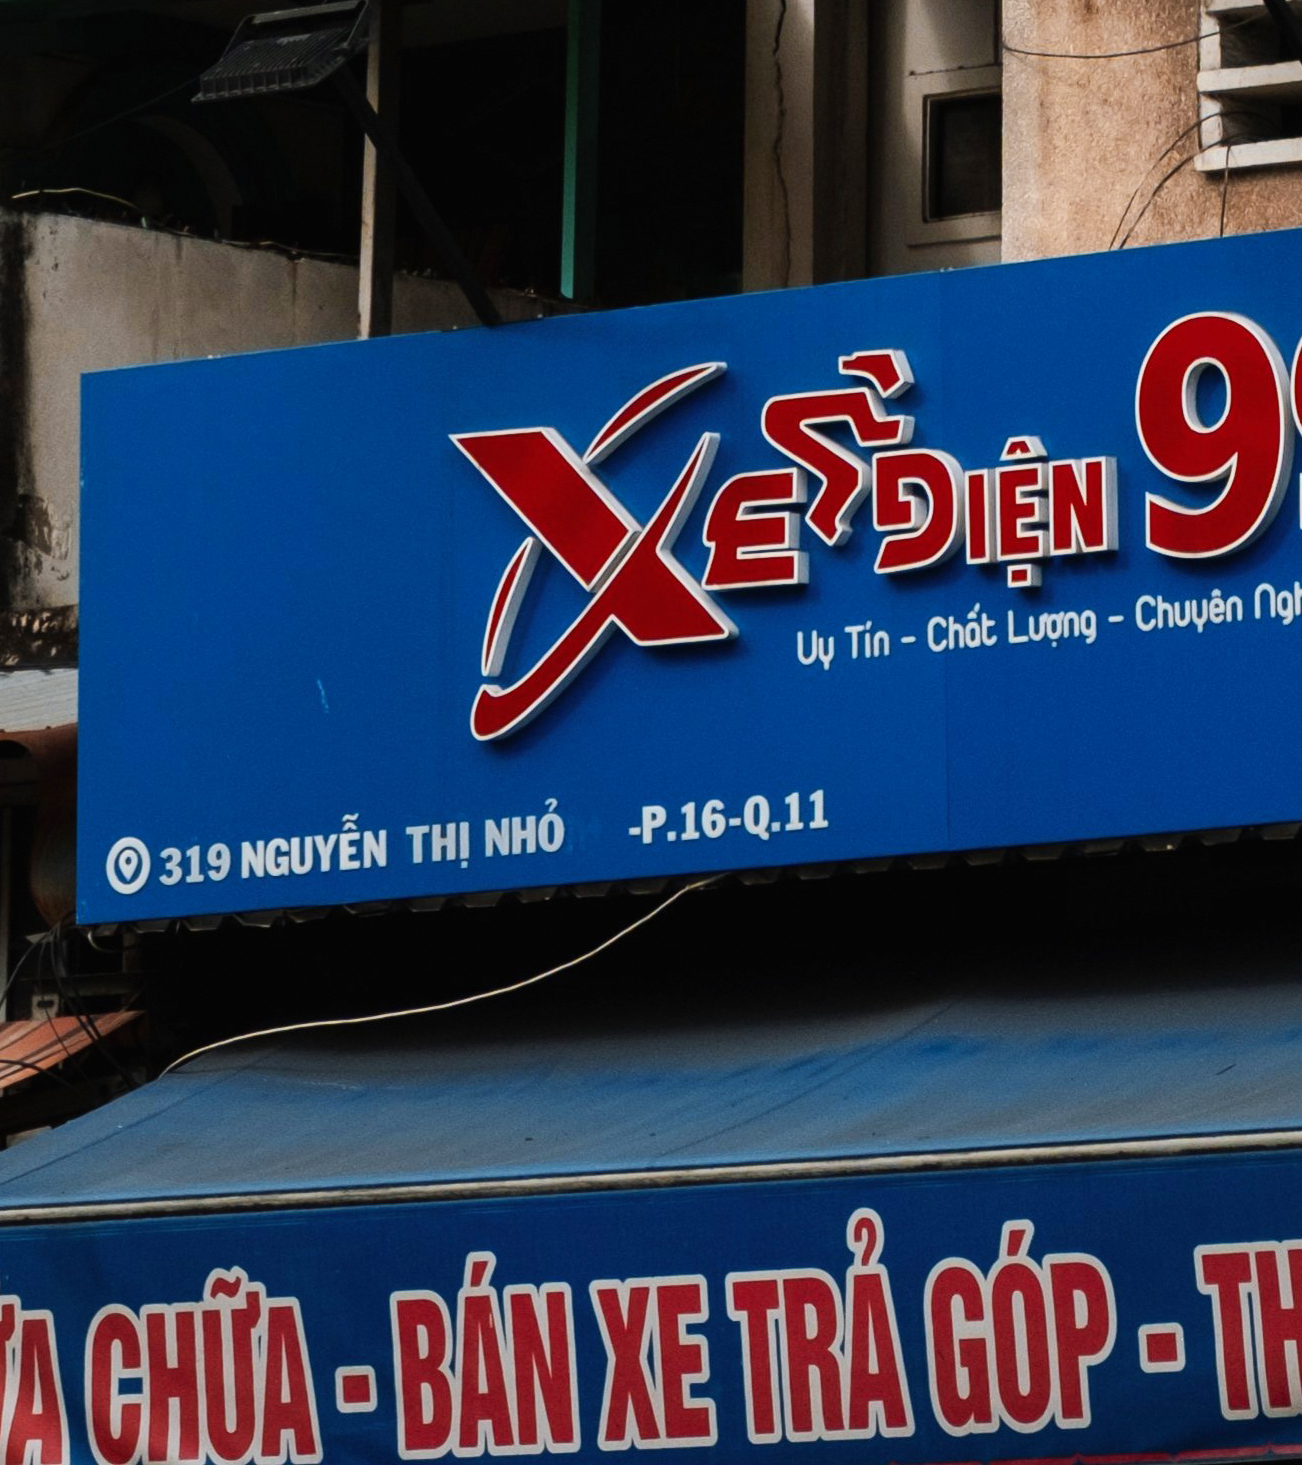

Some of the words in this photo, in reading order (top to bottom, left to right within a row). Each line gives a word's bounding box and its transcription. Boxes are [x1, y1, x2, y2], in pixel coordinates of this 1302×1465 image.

[873, 436, 1119, 589] ĐIỆN
[796, 629, 836, 671] Uy
[844, 620, 891, 660] Tín
[926, 601, 998, 654] Chất
[1007, 608, 1098, 649] Lượng
[1134, 587, 1244, 633] Chuyên
[158, 843, 231, 887] 319
[239, 813, 388, 880] NGUYỄN
[406, 822, 470, 869] THỊ
[484, 798, 565, 857] NHỎ
[0, 1294, 70, 1465] A
[85, 1269, 321, 1465] CHỮA
[392, 1253, 578, 1459] BÁN
[592, 1275, 716, 1449] XE
[727, 1209, 913, 1443] TRẢ
[926, 1221, 1115, 1433] GÓP
